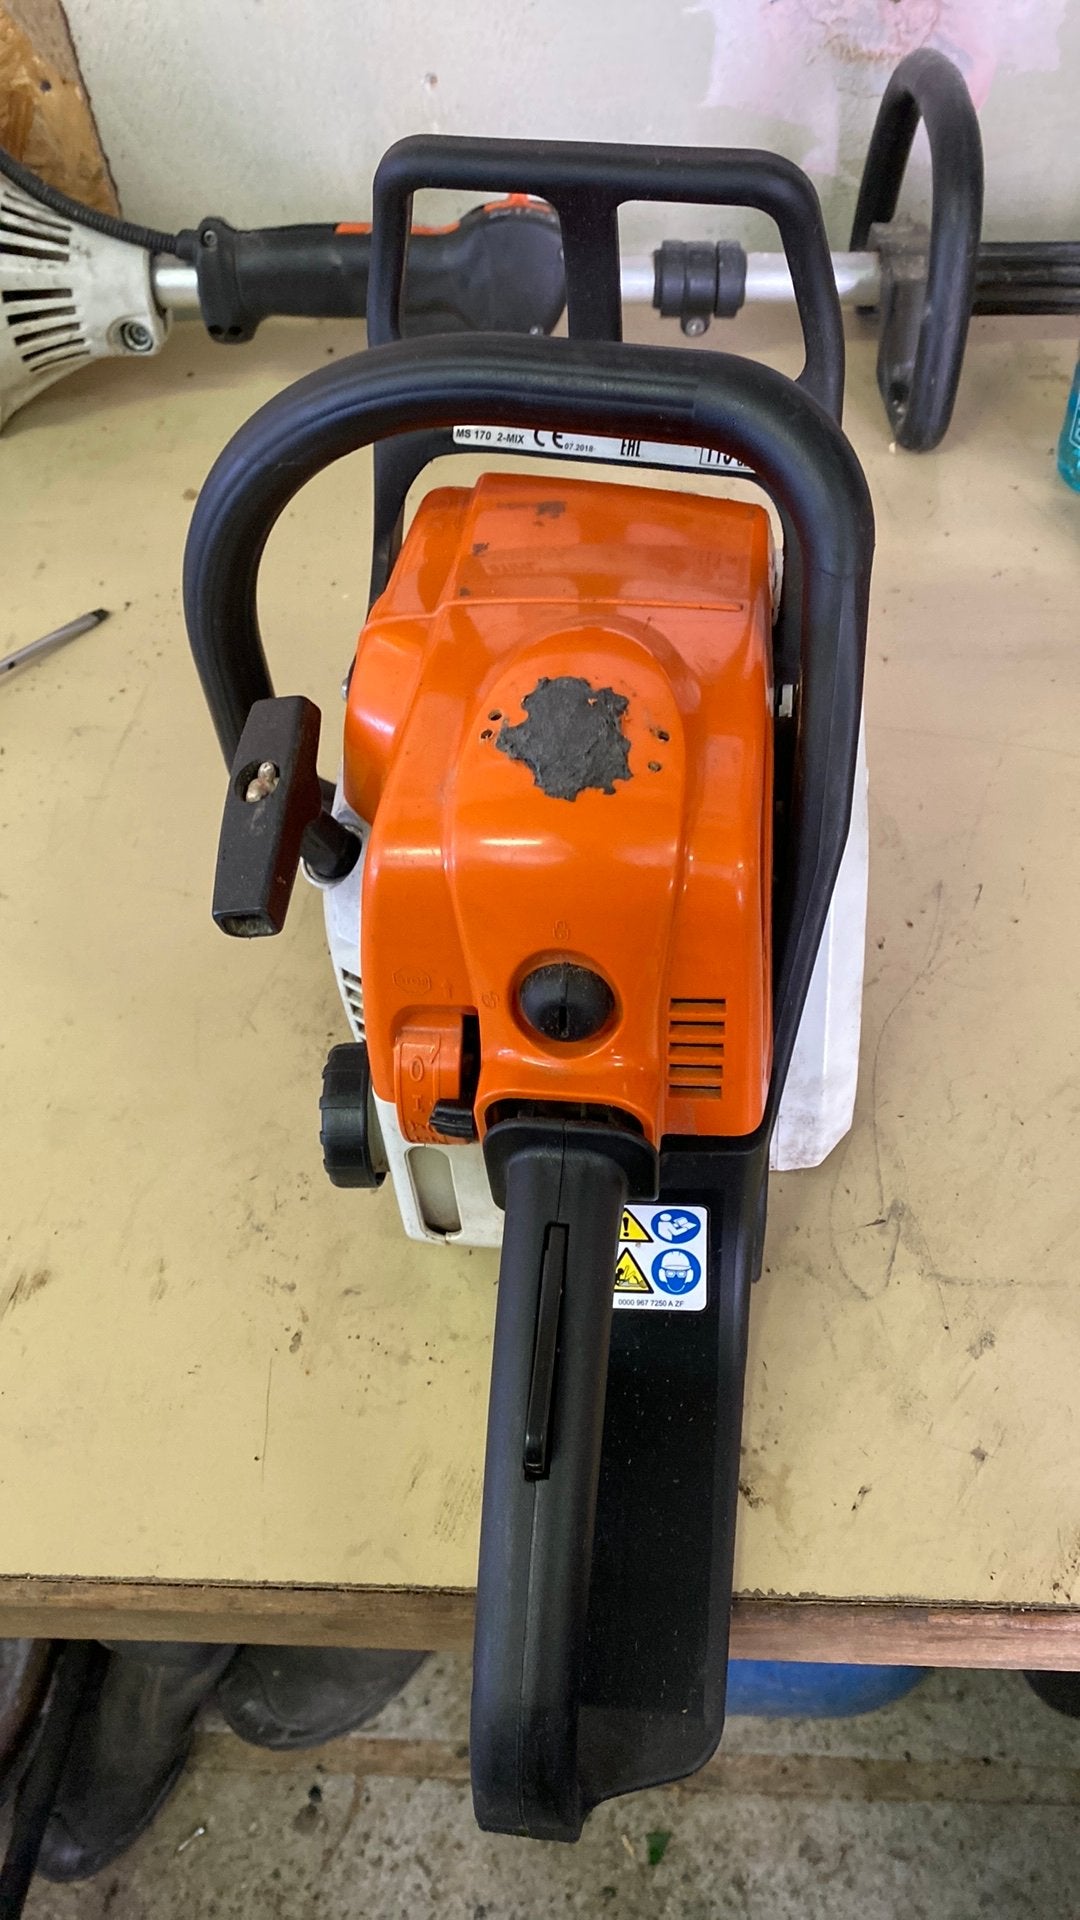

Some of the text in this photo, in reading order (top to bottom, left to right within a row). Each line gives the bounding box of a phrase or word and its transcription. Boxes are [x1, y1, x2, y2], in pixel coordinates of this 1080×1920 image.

[456, 428, 525, 445] MS 170 2-MIX
[618, 1298, 635, 1306] 0000
[651, 1299, 667, 1308] 7250
[675, 1300, 685, 1308] ZF
